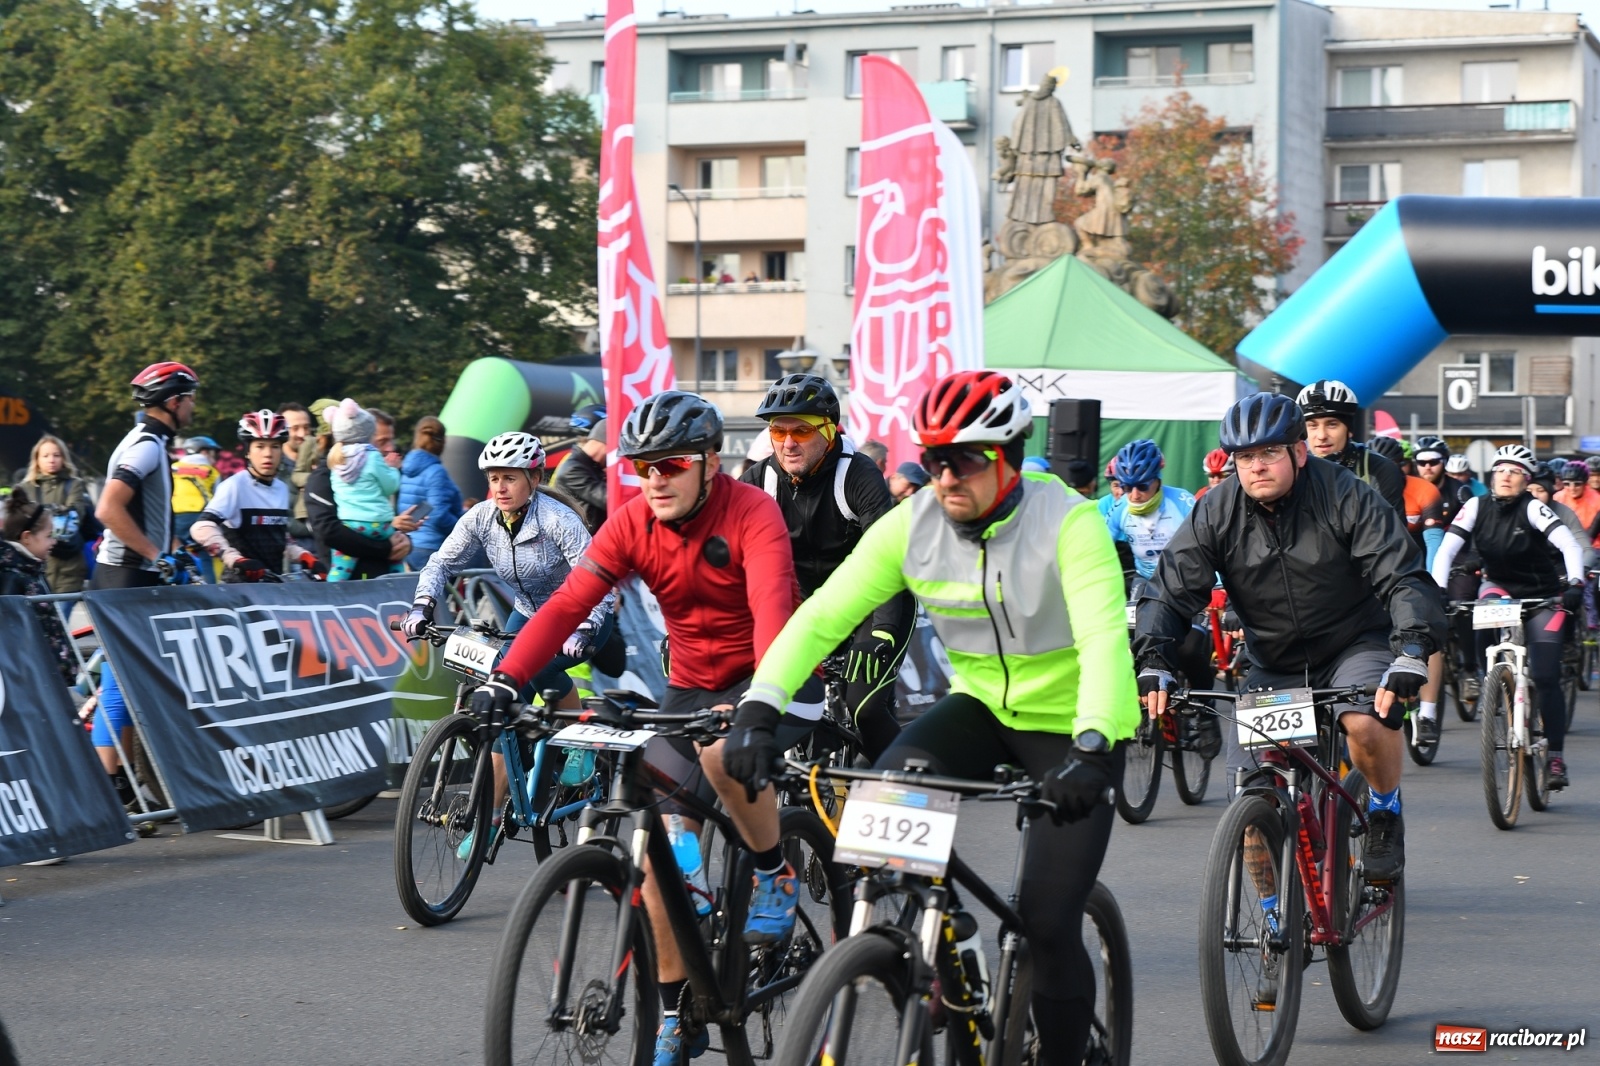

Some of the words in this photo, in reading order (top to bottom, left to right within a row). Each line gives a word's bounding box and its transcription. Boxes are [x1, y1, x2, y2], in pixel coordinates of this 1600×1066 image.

[1447, 378, 1473, 411] 0
[453, 642, 487, 665] 1002
[1252, 711, 1304, 733] 3263
[218, 726, 378, 796] USZCZELNIAMY
[858, 813, 931, 847] 3192
